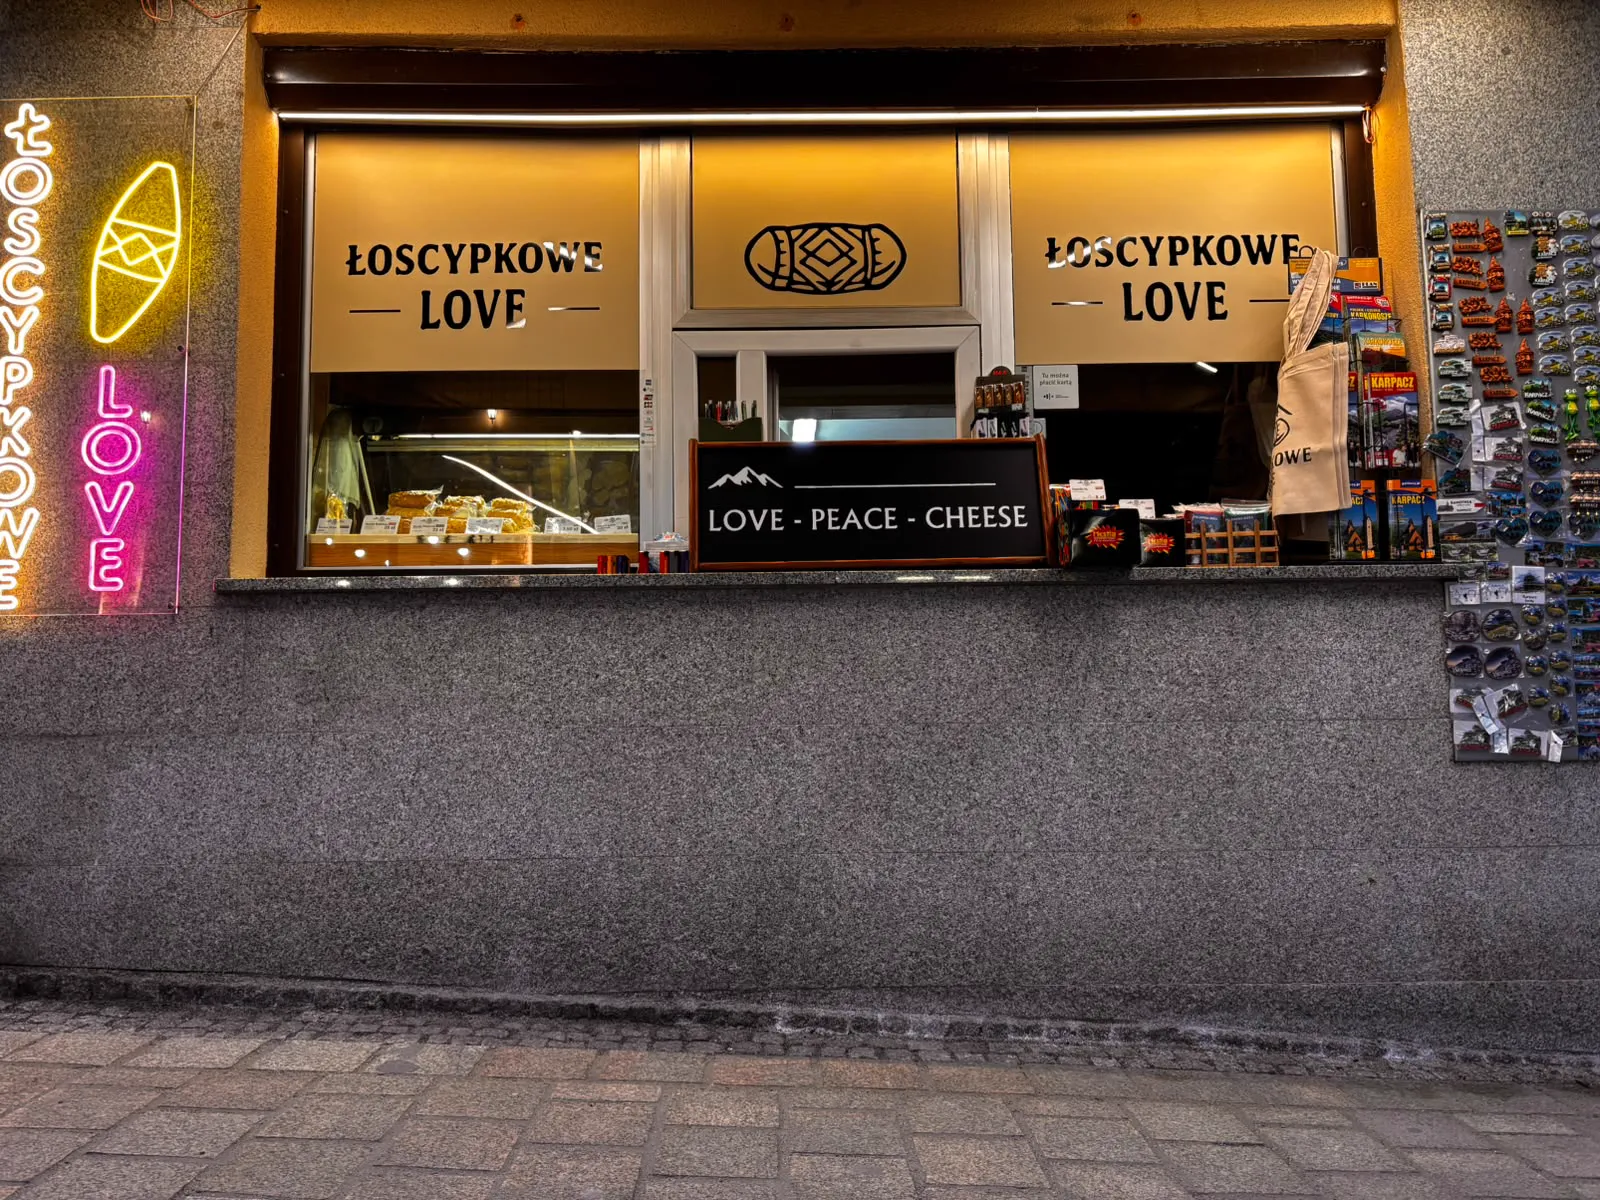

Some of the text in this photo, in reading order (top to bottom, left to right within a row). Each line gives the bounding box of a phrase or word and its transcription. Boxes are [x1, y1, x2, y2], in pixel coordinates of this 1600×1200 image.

[345, 241, 604, 276] ŁOSCYPKOWE
[420, 288, 527, 330] LOVE
[1122, 281, 1228, 322] LOVE
[1371, 376, 1415, 389] KARPACZ
[1274, 447, 1312, 467] OWE
[81, 365, 141, 592] LOVE
[708, 509, 785, 532] LOVE
[811, 507, 898, 531] PEACE
[925, 505, 1028, 529] CHEESE
